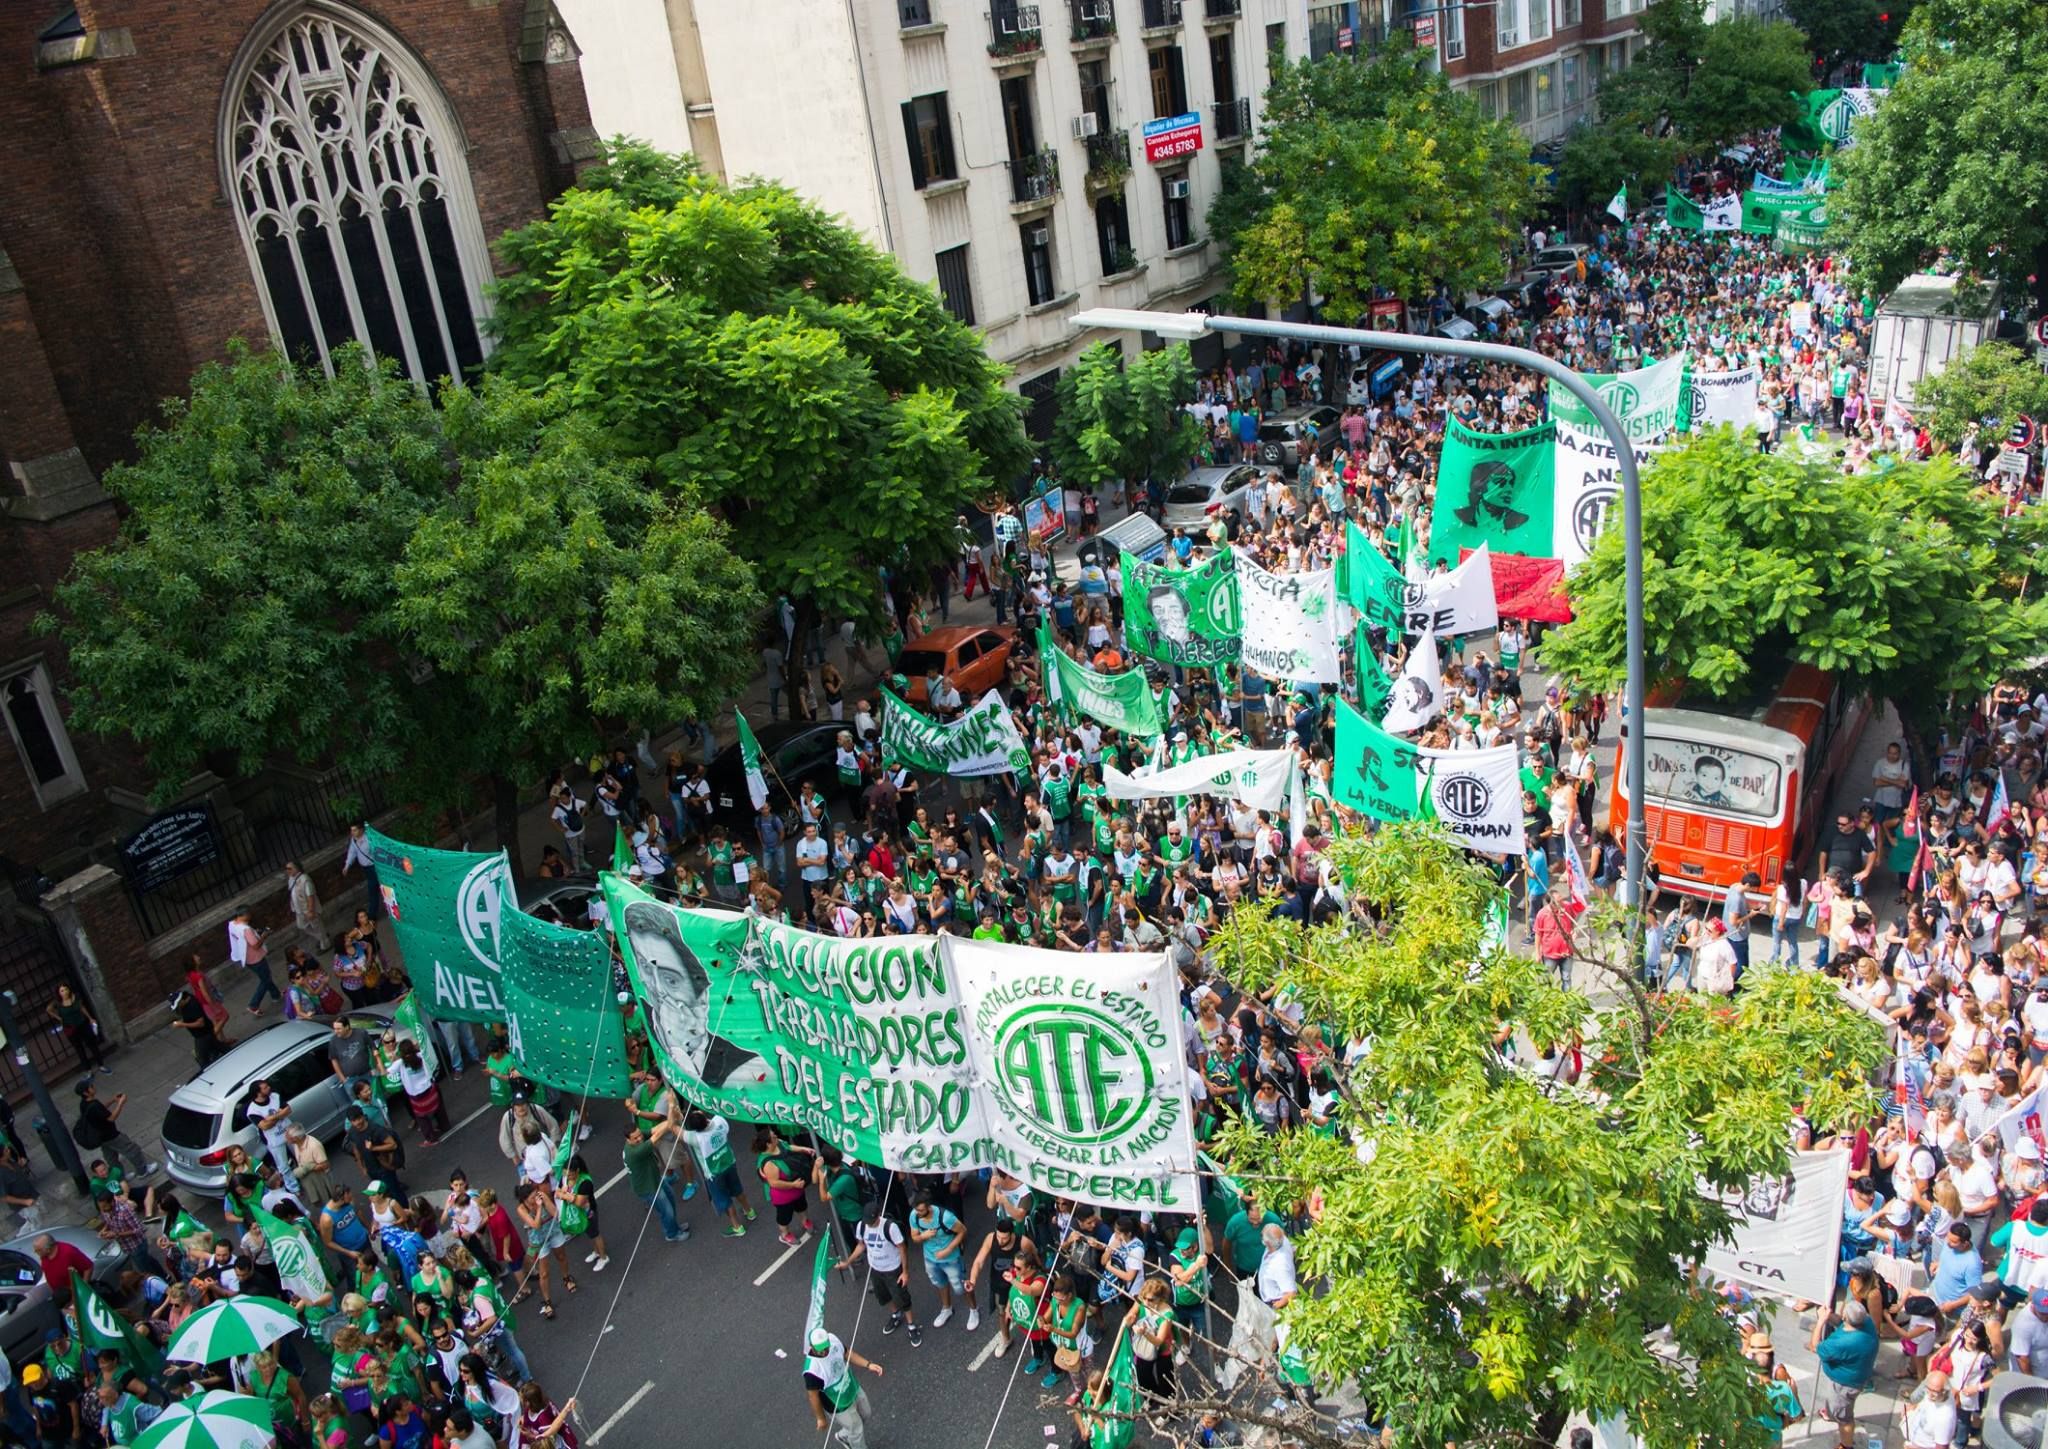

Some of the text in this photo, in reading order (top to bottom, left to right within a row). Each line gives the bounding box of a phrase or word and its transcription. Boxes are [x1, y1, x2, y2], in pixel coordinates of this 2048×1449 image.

[1154, 138, 1196, 158] 4345 5783
[1755, 196, 1783, 204] MUSEO
[1701, 372, 1753, 387] BONAPARTE
[1451, 430, 1500, 450] JUNTA
[1500, 426, 1577, 450] INTERNA
[1580, 443, 1617, 460] ATE
[1202, 554, 1300, 602] JUSTICIA
[1366, 594, 1456, 632] ENRE
[1245, 643, 1297, 673] HUMANOS
[1690, 744, 1733, 762] EL REY
[1444, 780, 1483, 816] ATE
[1730, 775, 1742, 787] DE
[1348, 786, 1410, 820] LA VERDE
[745, 918, 948, 1004] ASOCIACION
[752, 978, 967, 1068] TRABAJADORES
[976, 976, 1167, 1050] FORTALECER EL ESTADO
[775, 1045, 971, 1136] DEL ESTADO
[1004, 1018, 1135, 1134] ATE
[742, 1095, 858, 1152] DIRECTIVO
[1016, 1123, 1095, 1165] LIBERAR
[1099, 1146, 1126, 1167] LA
[1127, 1096, 1182, 1160] NACION
[901, 1137, 1180, 1206] CAPITAL FEDERAL
[1738, 1260, 1786, 1281] CTA
